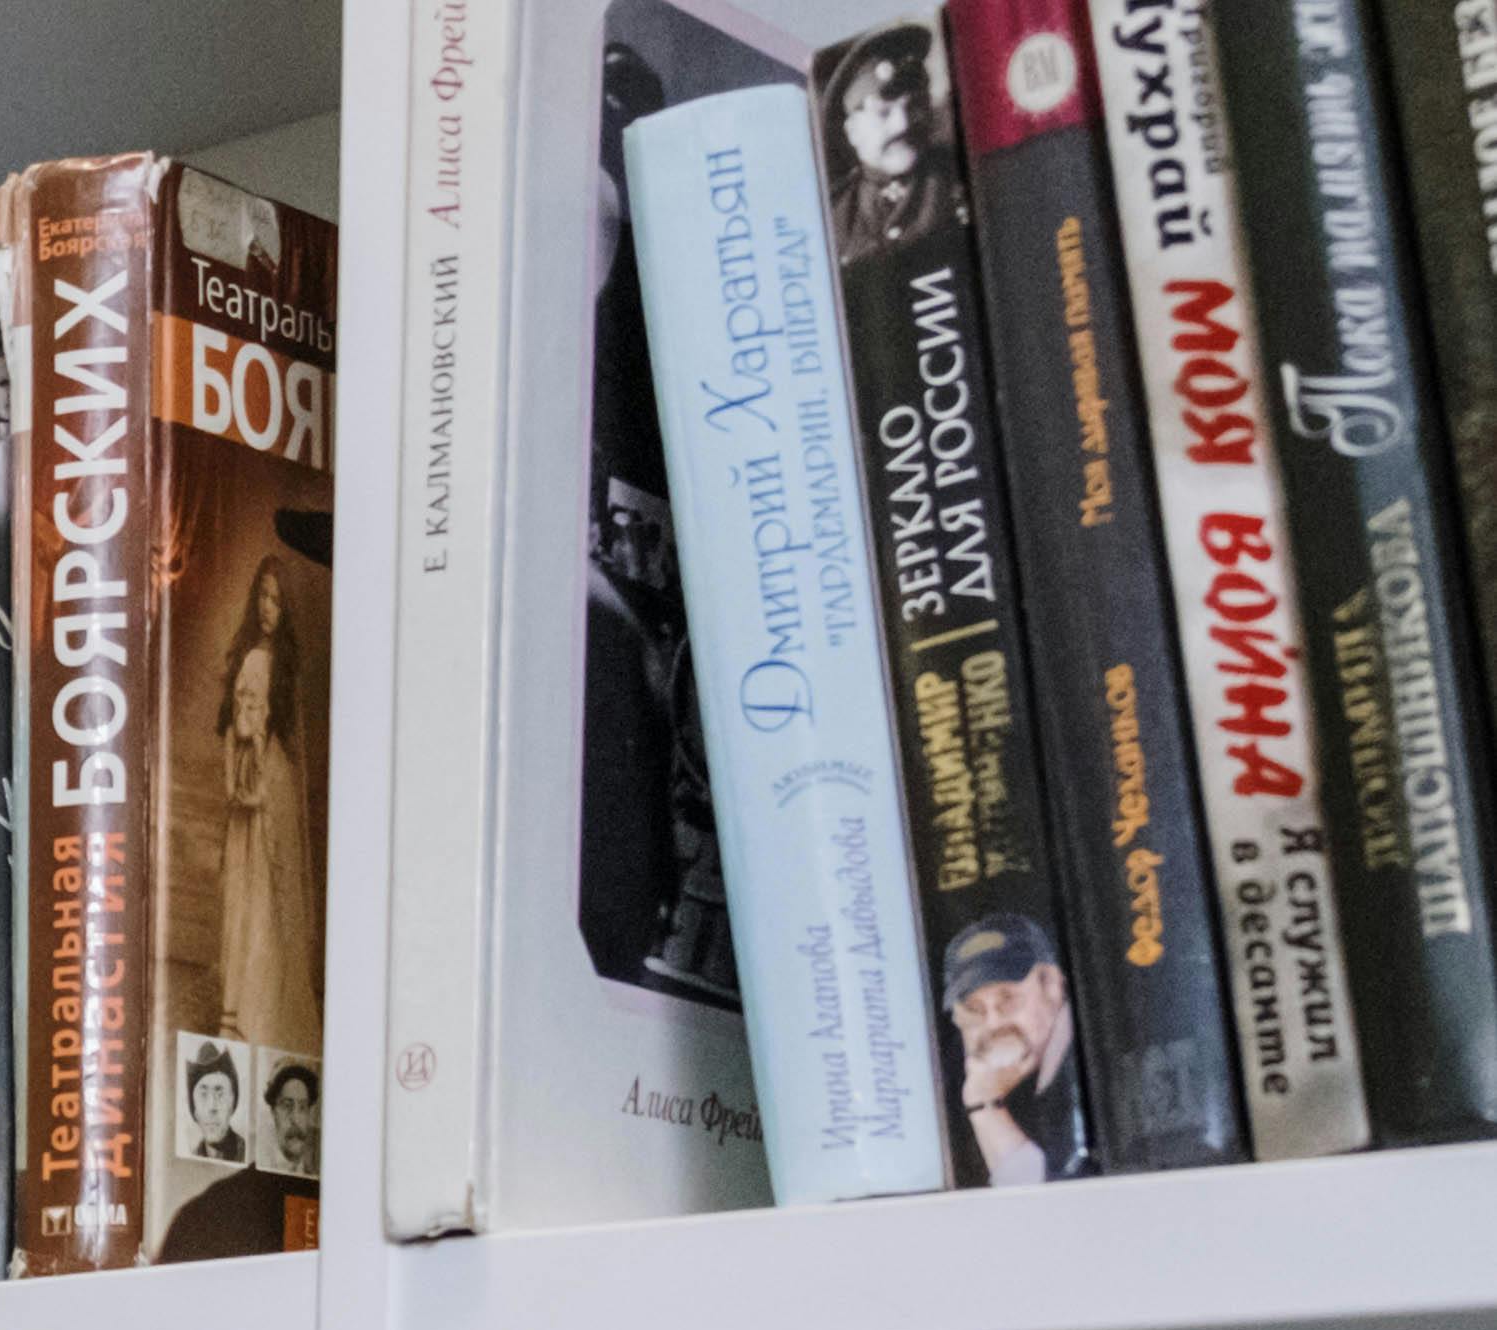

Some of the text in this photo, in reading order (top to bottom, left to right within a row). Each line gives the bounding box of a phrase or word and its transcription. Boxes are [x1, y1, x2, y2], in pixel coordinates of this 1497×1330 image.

[424, 253, 460, 574] Е. КАЛМАНОВСКИЙ
[700, 144, 814, 732] Дмитрий Харатьян
[877, 402, 946, 622] ЗЕРКАЛО
[913, 267, 978, 489] РОССИИ
[52, 270, 131, 807] БОЯРСКИХ
[939, 499, 996, 602] ДЛЯ
[1161, 279, 1306, 799] МОЯ ВОЙНА
[42, 835, 81, 1180] Театральная
[797, 924, 857, 1151] Ирина Агапова
[830, 815, 909, 1141] Маргарита Давыдова
[1236, 879, 1291, 1096] десанте
[1281, 826, 1338, 1061] Я служил
